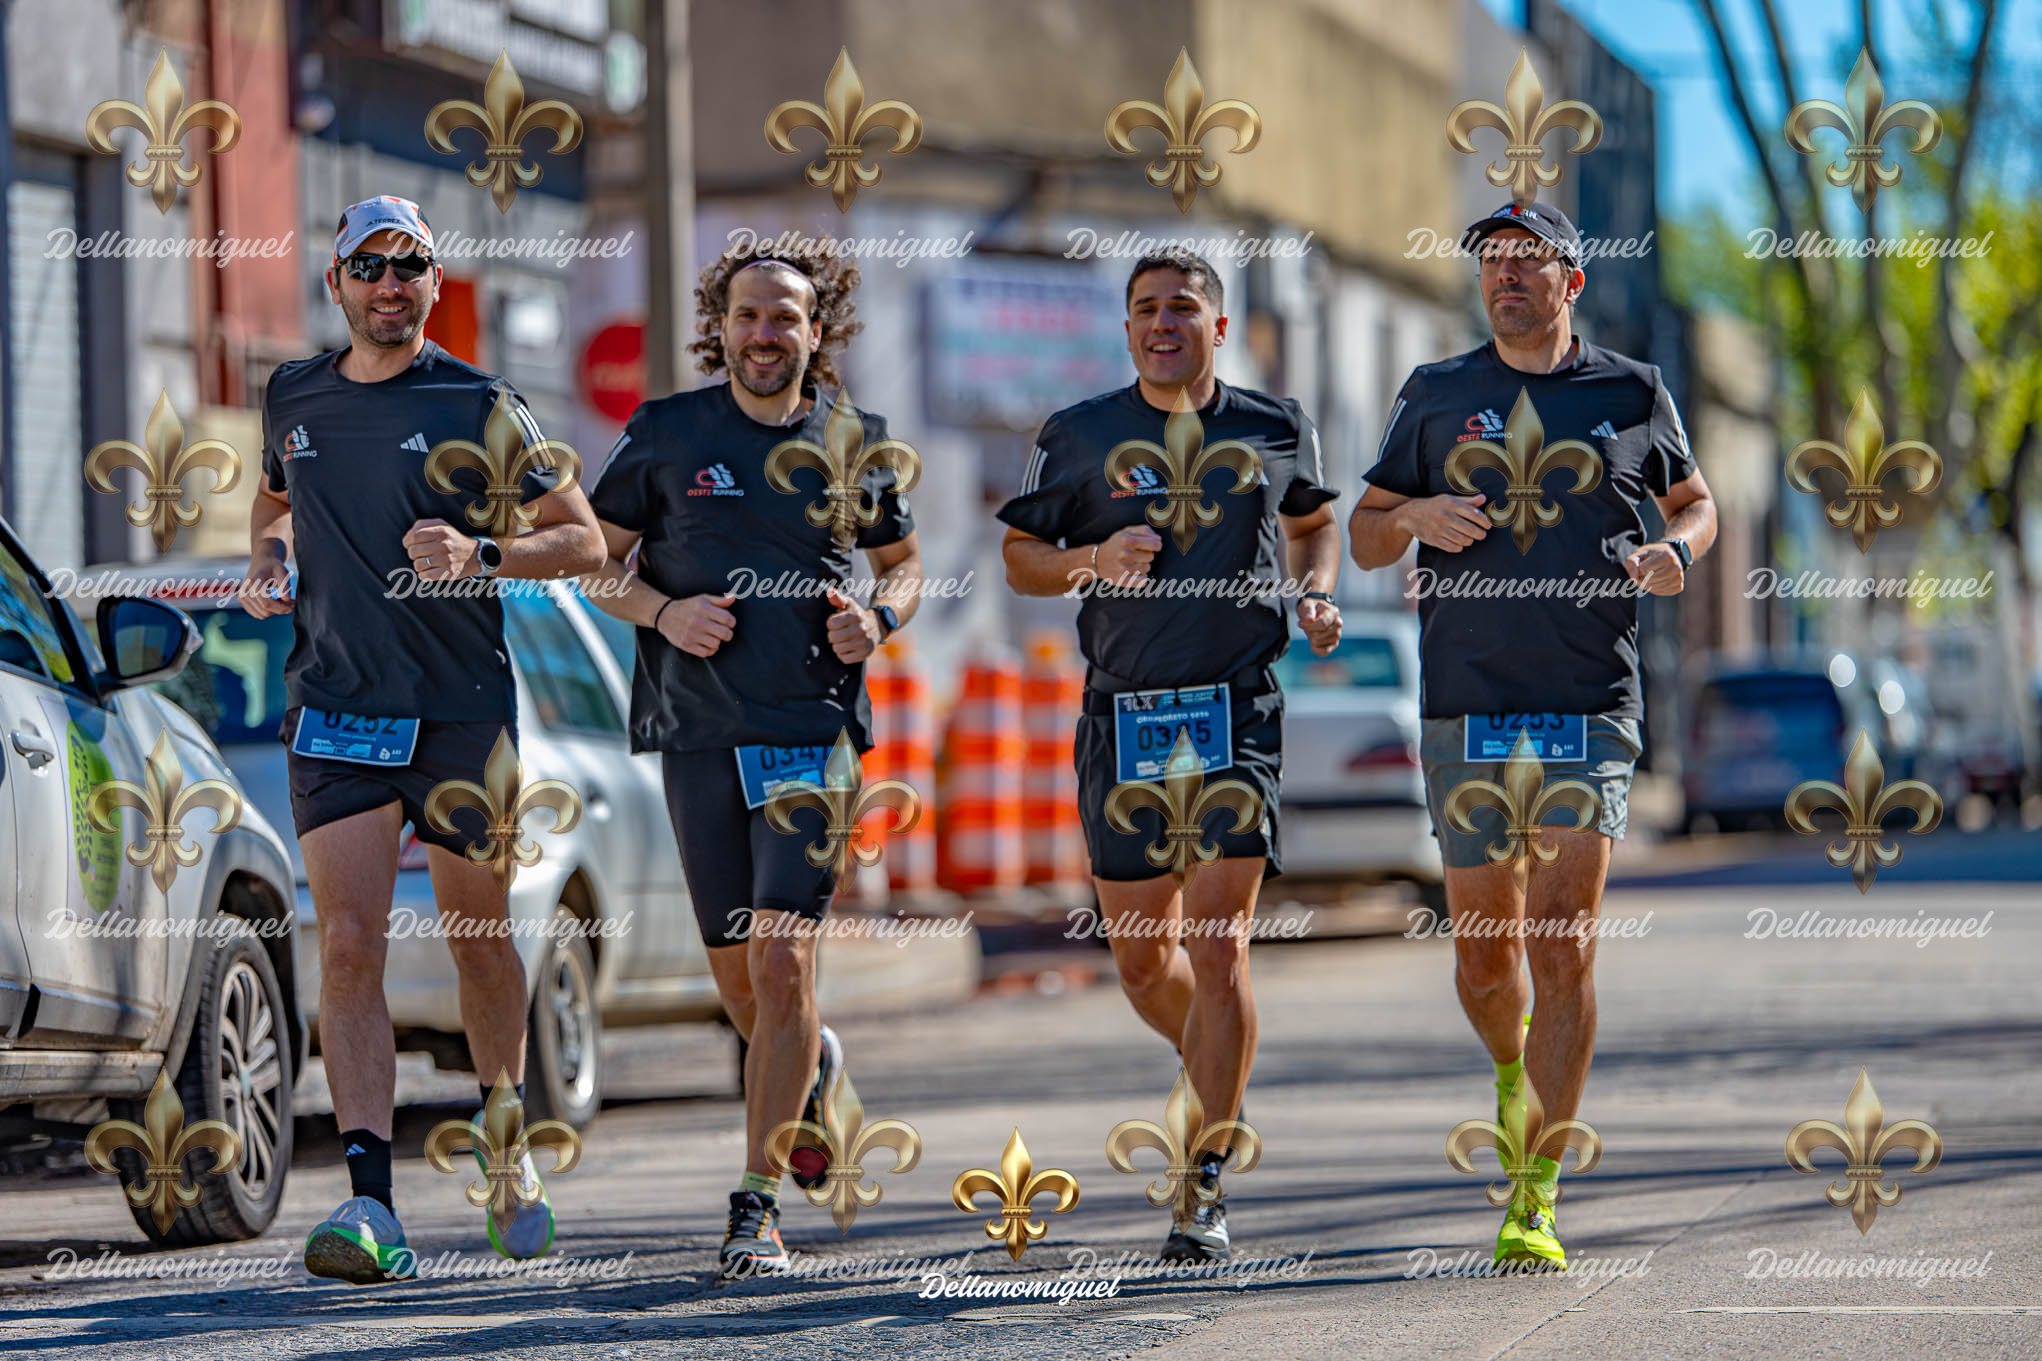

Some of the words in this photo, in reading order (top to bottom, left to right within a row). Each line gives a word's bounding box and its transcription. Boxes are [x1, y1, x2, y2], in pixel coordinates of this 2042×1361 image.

[1481, 432, 1512, 440] RUNNING
[687, 488, 712, 497] OESTE
[712, 488, 745, 497] RUNNING
[760, 746, 834, 770] 034
